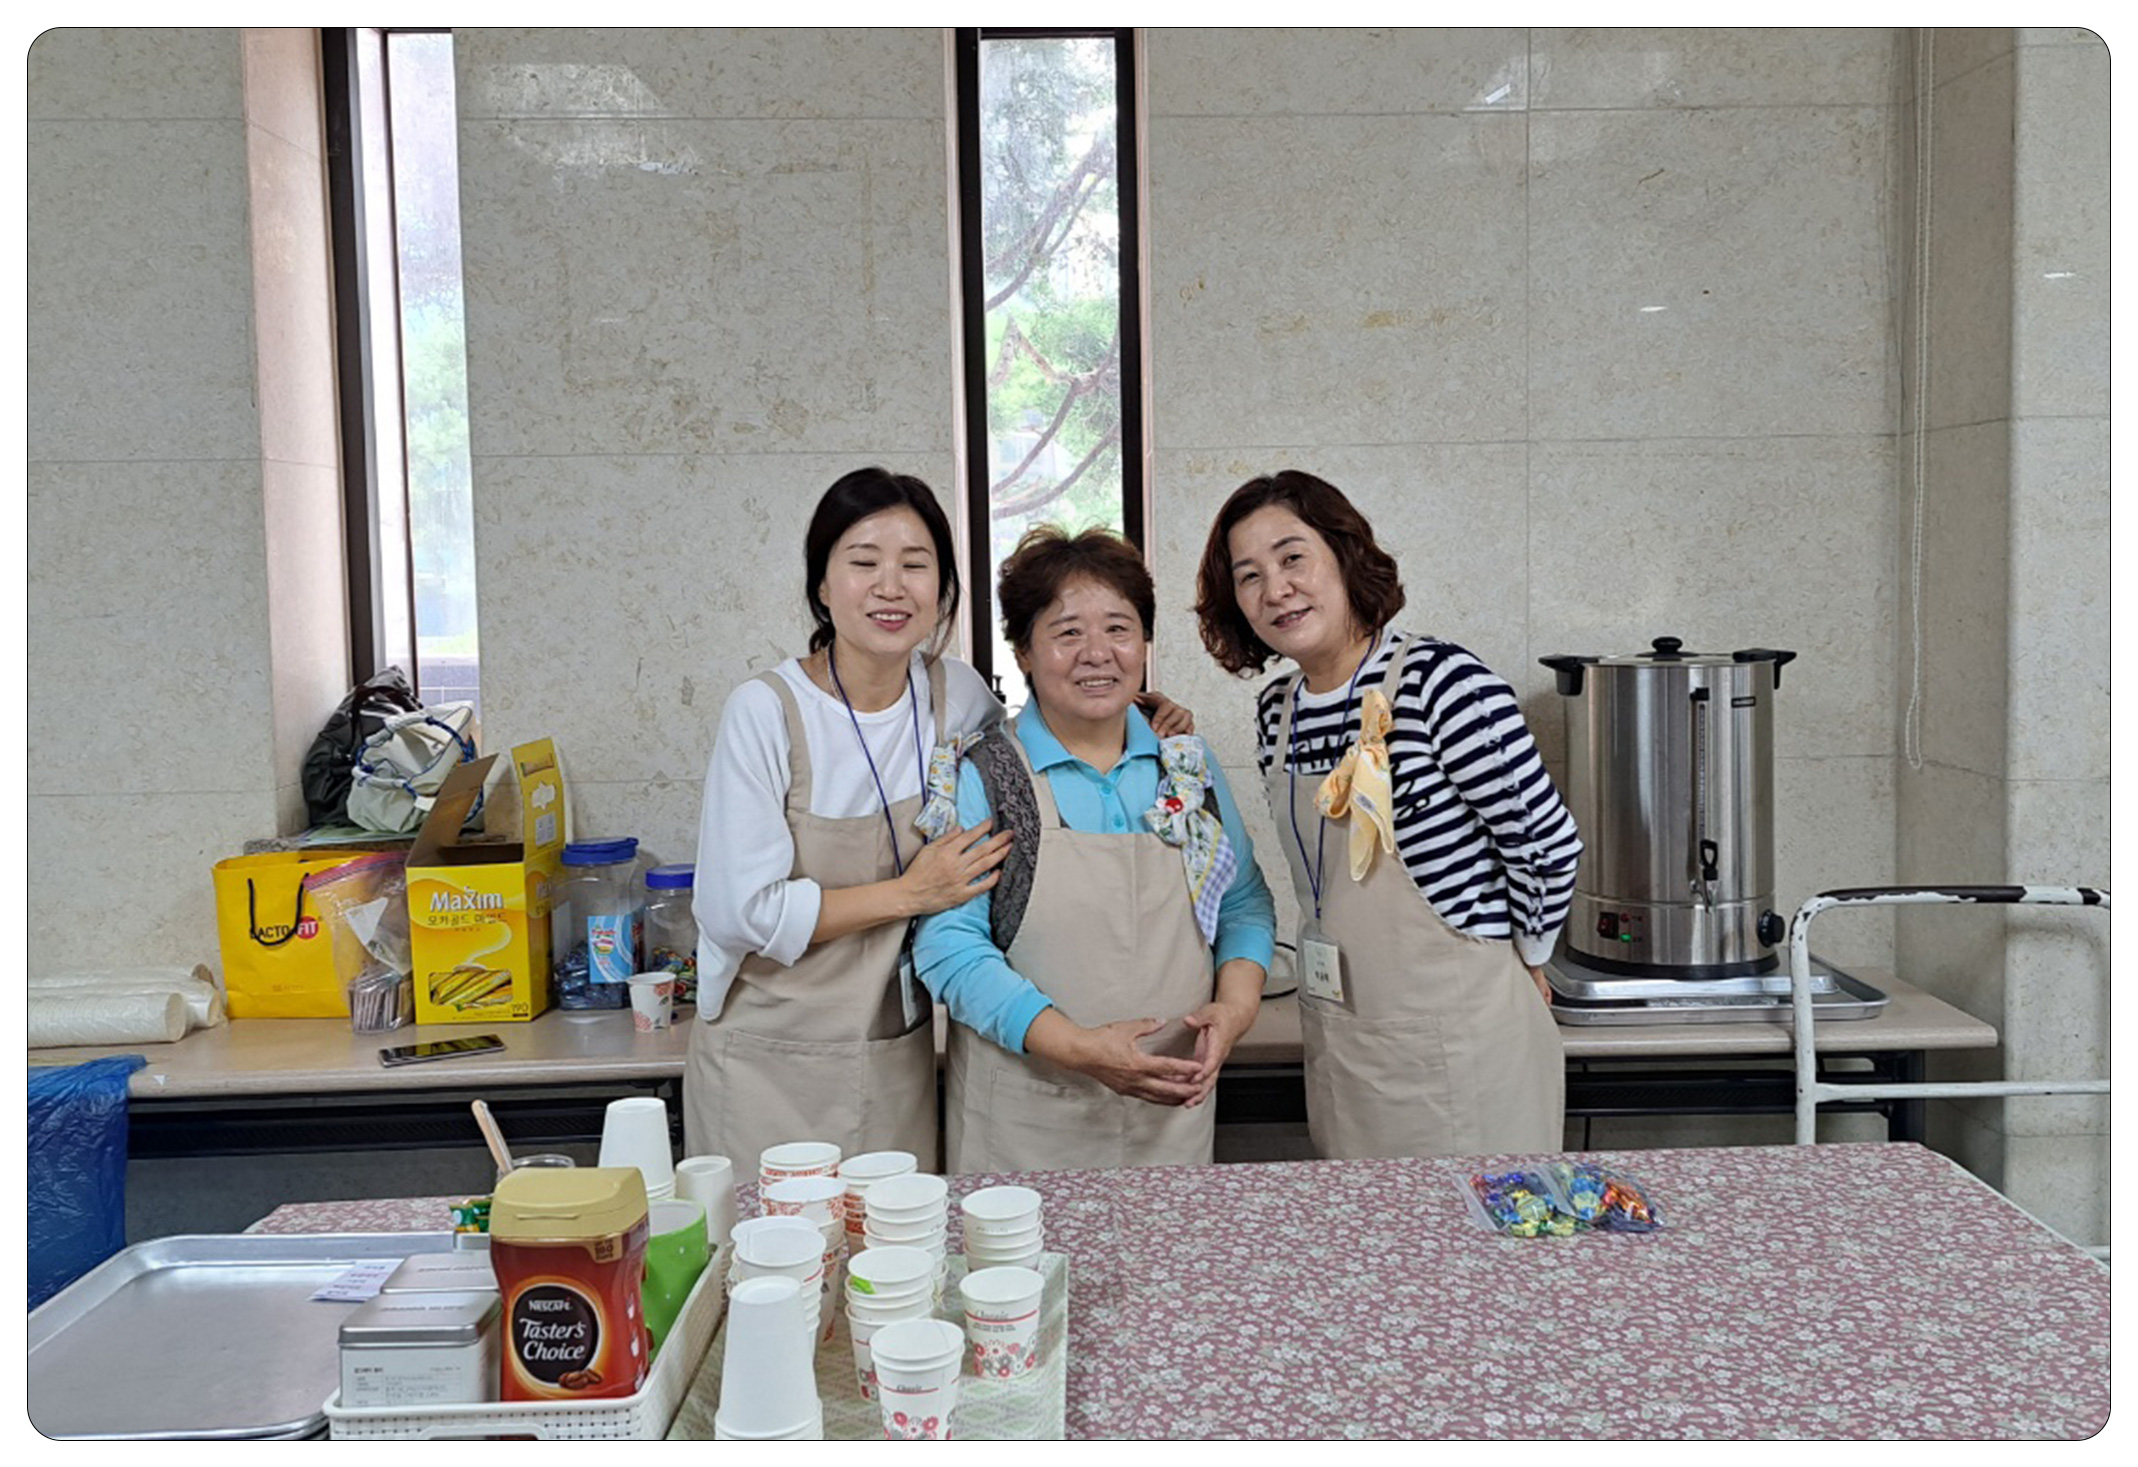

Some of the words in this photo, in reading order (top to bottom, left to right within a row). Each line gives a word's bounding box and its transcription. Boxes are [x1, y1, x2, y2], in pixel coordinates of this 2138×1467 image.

[430, 886, 503, 912] Maxim
[428, 914, 471, 926] 모카골드
[519, 1317, 586, 1339] Taster's
[523, 1340, 585, 1361] Choice
